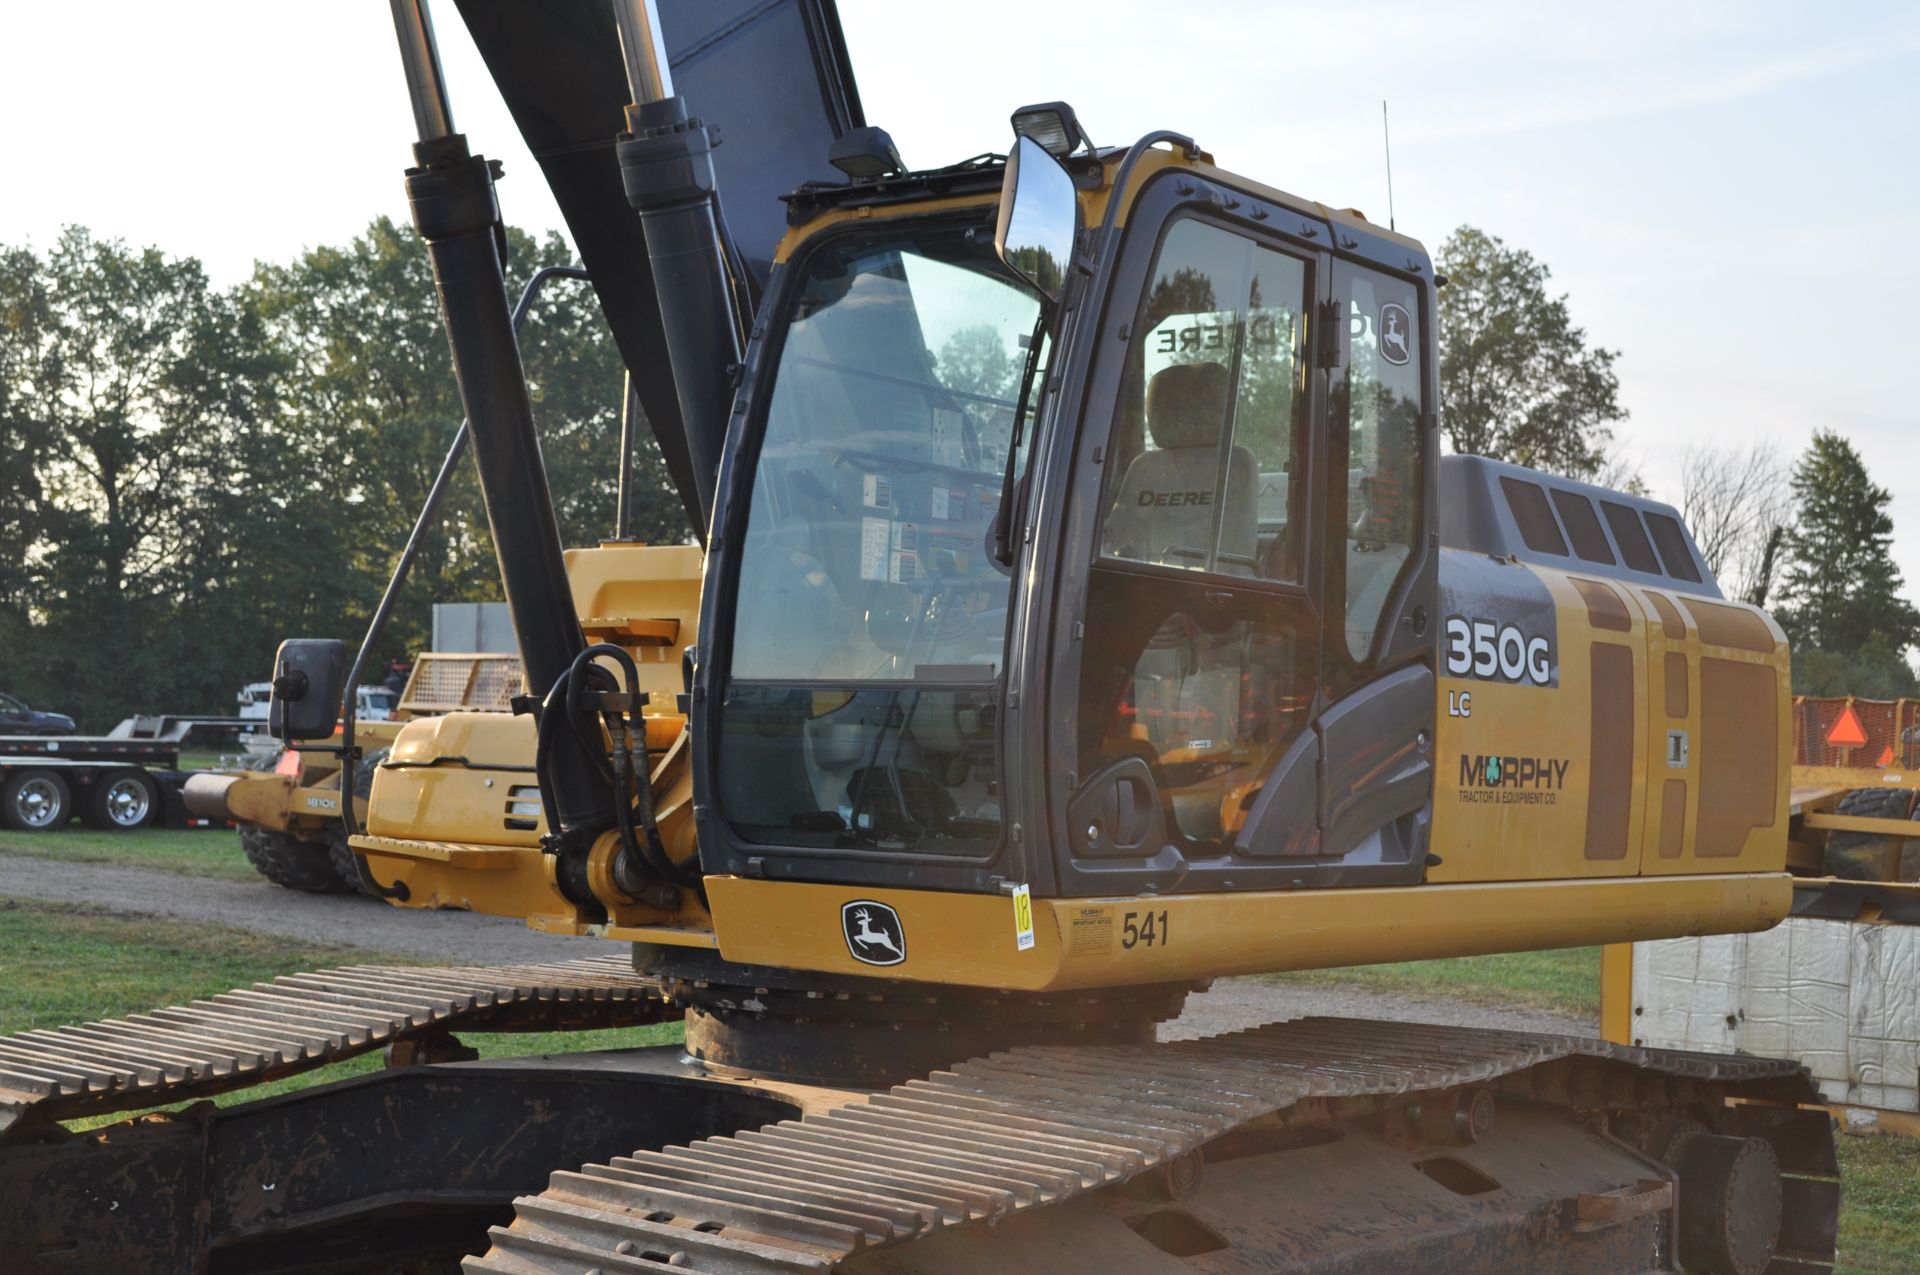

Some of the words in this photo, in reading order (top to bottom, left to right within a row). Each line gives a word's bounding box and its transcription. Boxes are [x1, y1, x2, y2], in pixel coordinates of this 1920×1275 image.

[1137, 490, 1213, 508] DEERE
[1446, 615, 1550, 686] 350G
[1449, 690, 1471, 717] LC
[1459, 790, 1494, 804] TRACTOR
[1495, 792, 1501, 804] &
[1503, 791, 1544, 805] EQUIPMENT
[1544, 792, 1557, 805] CO.
[1016, 894, 1030, 932] 18
[1122, 910, 1168, 949] 541
